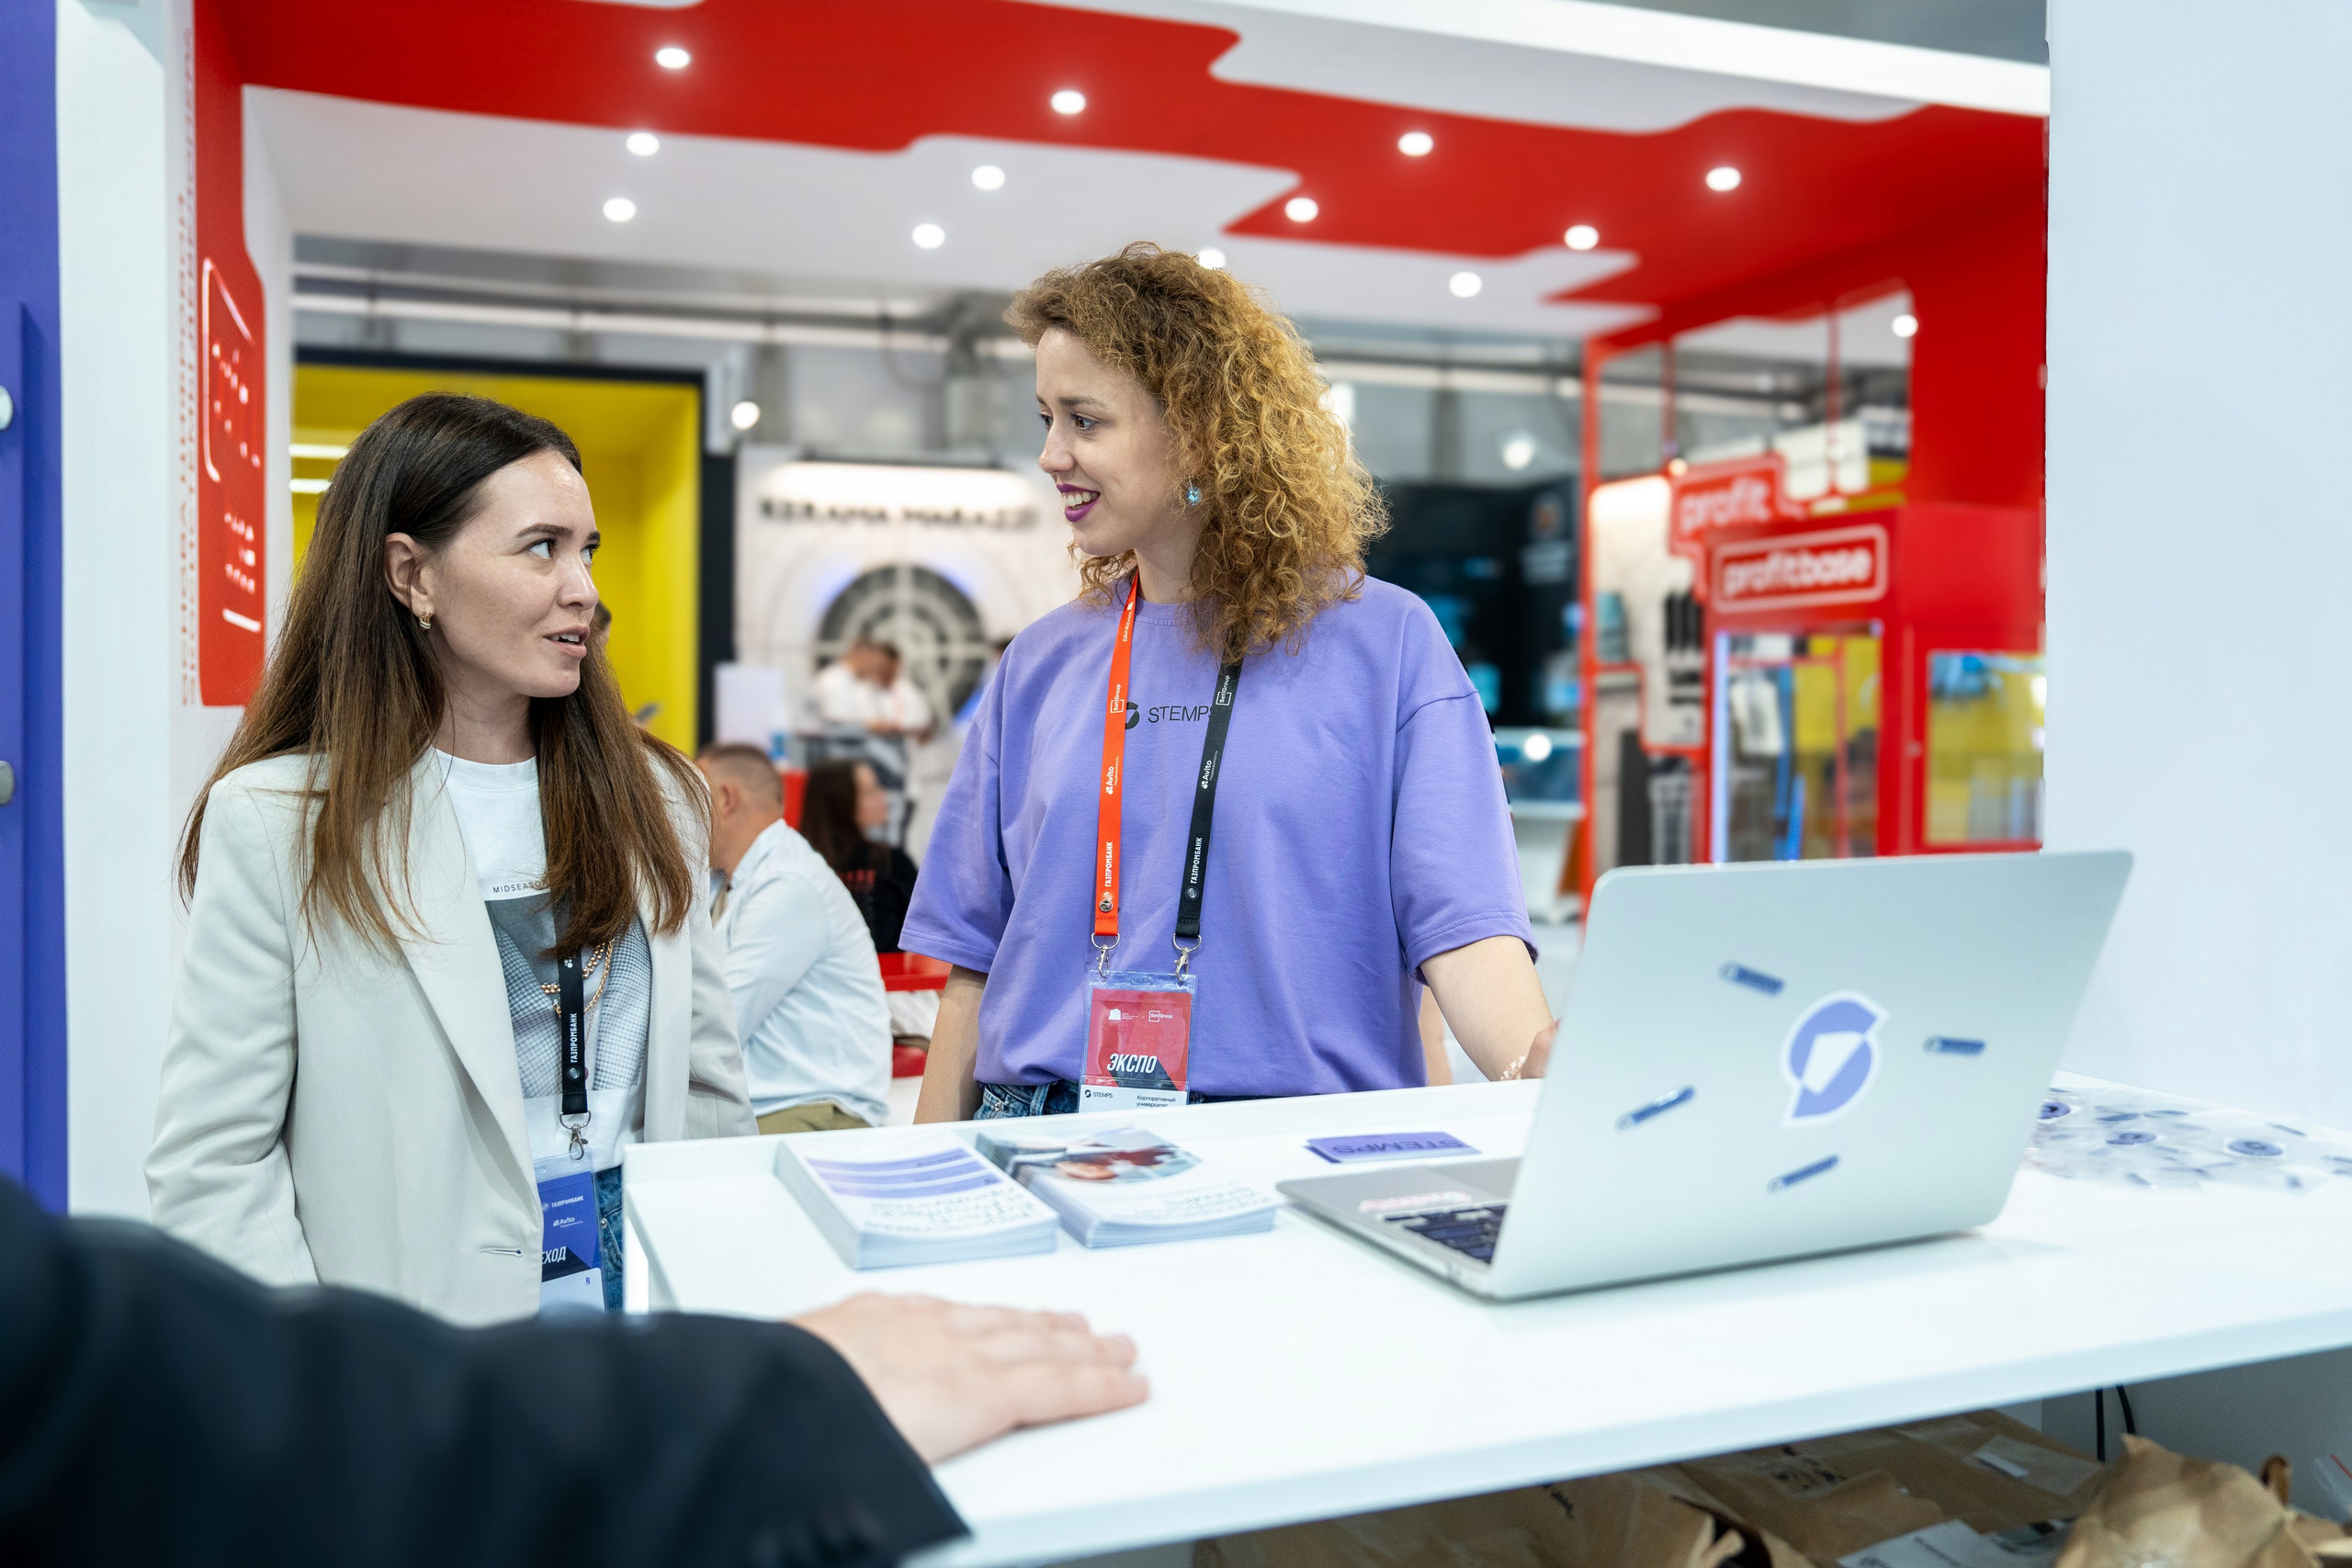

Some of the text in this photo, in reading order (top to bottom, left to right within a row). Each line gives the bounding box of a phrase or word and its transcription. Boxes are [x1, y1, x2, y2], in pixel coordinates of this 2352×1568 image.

[1148, 705, 1212, 723] STEMP
[1106, 766, 1114, 786] Avito
[1202, 761, 1212, 781] Avito
[1190, 837, 1203, 884] ГАЗПРОМБАНК
[570, 1012, 578, 1063] ГАЗПРОМБАНК
[1106, 1053, 1158, 1074] ЭКСПО
[1333, 1139, 1464, 1154] STEMPS
[551, 1195, 584, 1208] ГАЗПРОМБАНК
[560, 1216, 575, 1225] Avito
